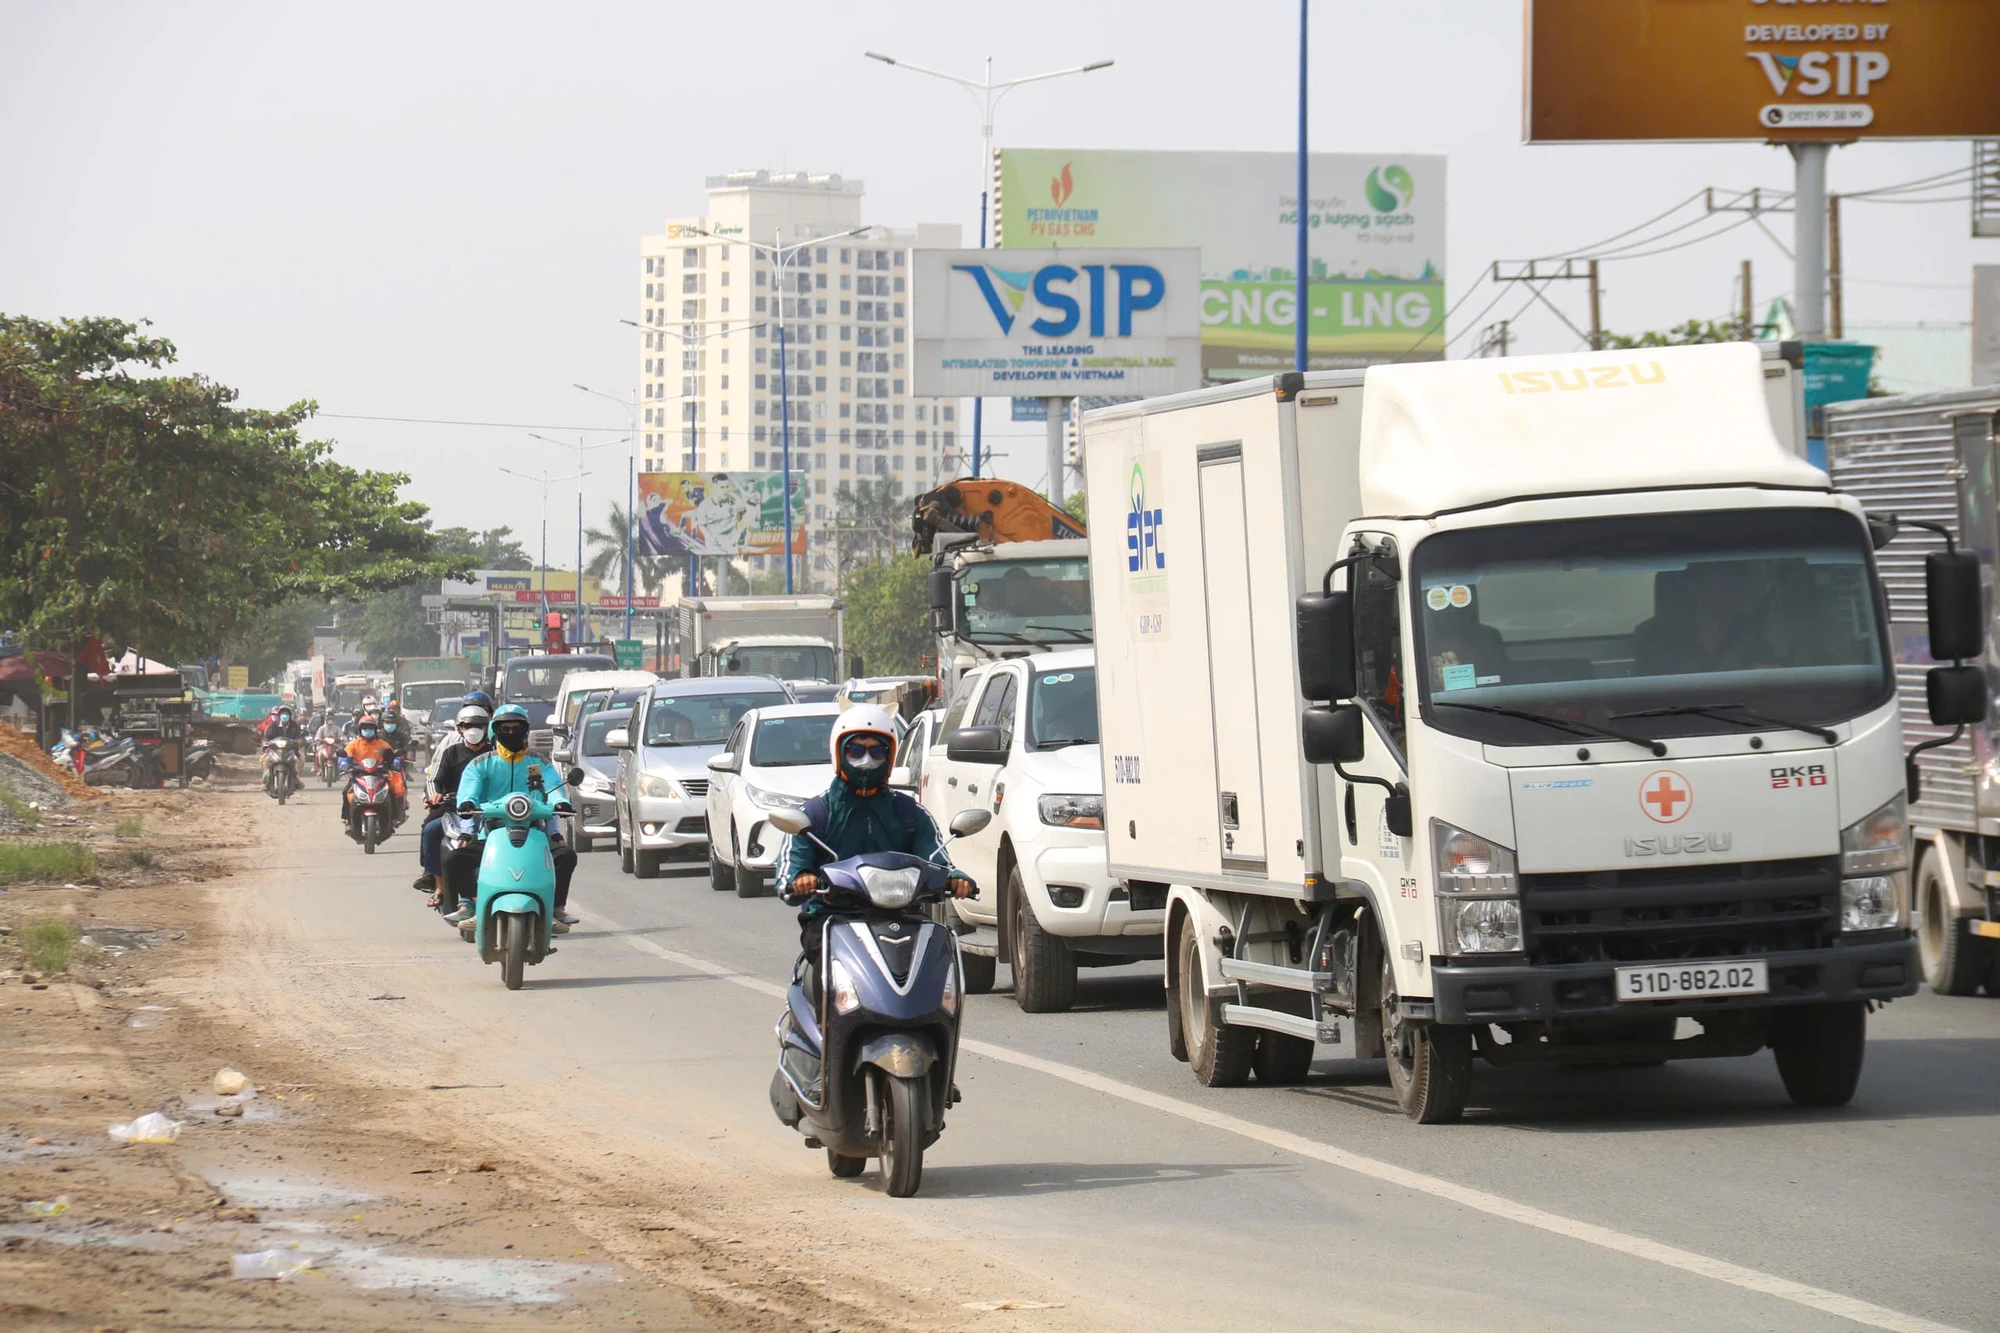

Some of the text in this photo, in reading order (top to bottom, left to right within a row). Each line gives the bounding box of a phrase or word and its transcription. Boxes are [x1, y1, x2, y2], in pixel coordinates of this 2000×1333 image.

[1745, 24, 1889, 42] DEVELOPED BY
[1746, 51, 1890, 96] VSIP
[951, 264, 1166, 337] VSIP
[1200, 289, 1297, 326] CNG
[1342, 291, 1432, 328] LNG
[1022, 345, 1094, 356] THE LEADING
[942, 359, 1008, 369] INTEGRATED
[1071, 358, 1079, 367] &
[993, 370, 1125, 381] DEVELOPER IN VIETNAM
[1497, 361, 1667, 395] ISUZU
[1770, 765, 1826, 778] QKR
[1771, 776, 1828, 789] 210
[1623, 831, 1732, 858] ISUZU
[1400, 878, 1417, 888] QKR
[1400, 887, 1418, 899] 210
[1630, 967, 1755, 994] 51D-882.02
